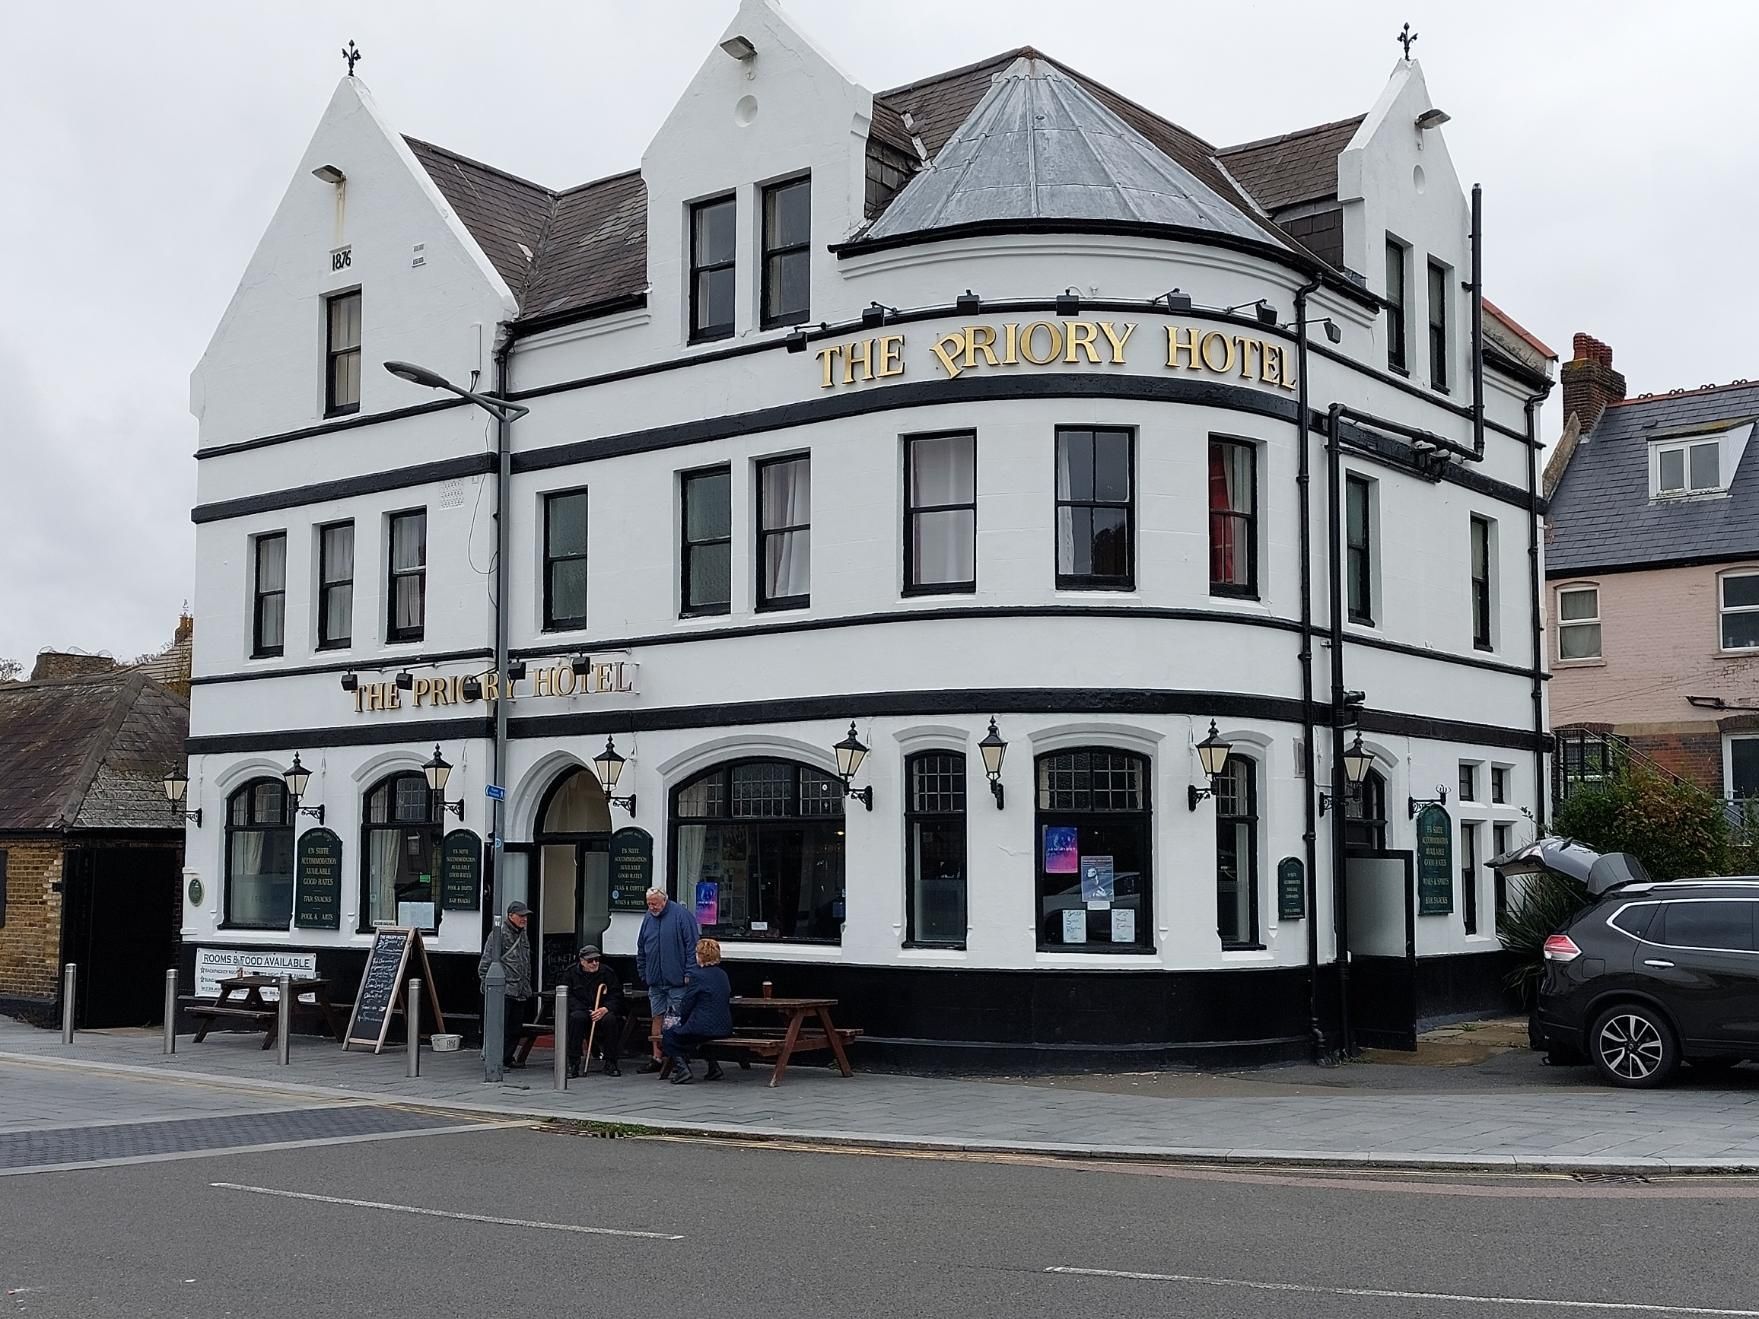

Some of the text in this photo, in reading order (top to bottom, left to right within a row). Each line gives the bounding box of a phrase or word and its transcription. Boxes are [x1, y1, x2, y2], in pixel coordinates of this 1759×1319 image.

[332, 249, 352, 272] 1876
[815, 320, 1297, 392] THE PRIORY HOTEL
[354, 682, 402, 712] THE
[532, 661, 633, 698] HOTEL
[305, 867, 331, 875] AVAILABLE
[318, 878, 334, 886] RATES
[314, 895, 332, 903] SNACKS
[203, 953, 311, 969] ROOMS & FOOD AVAILABLE
